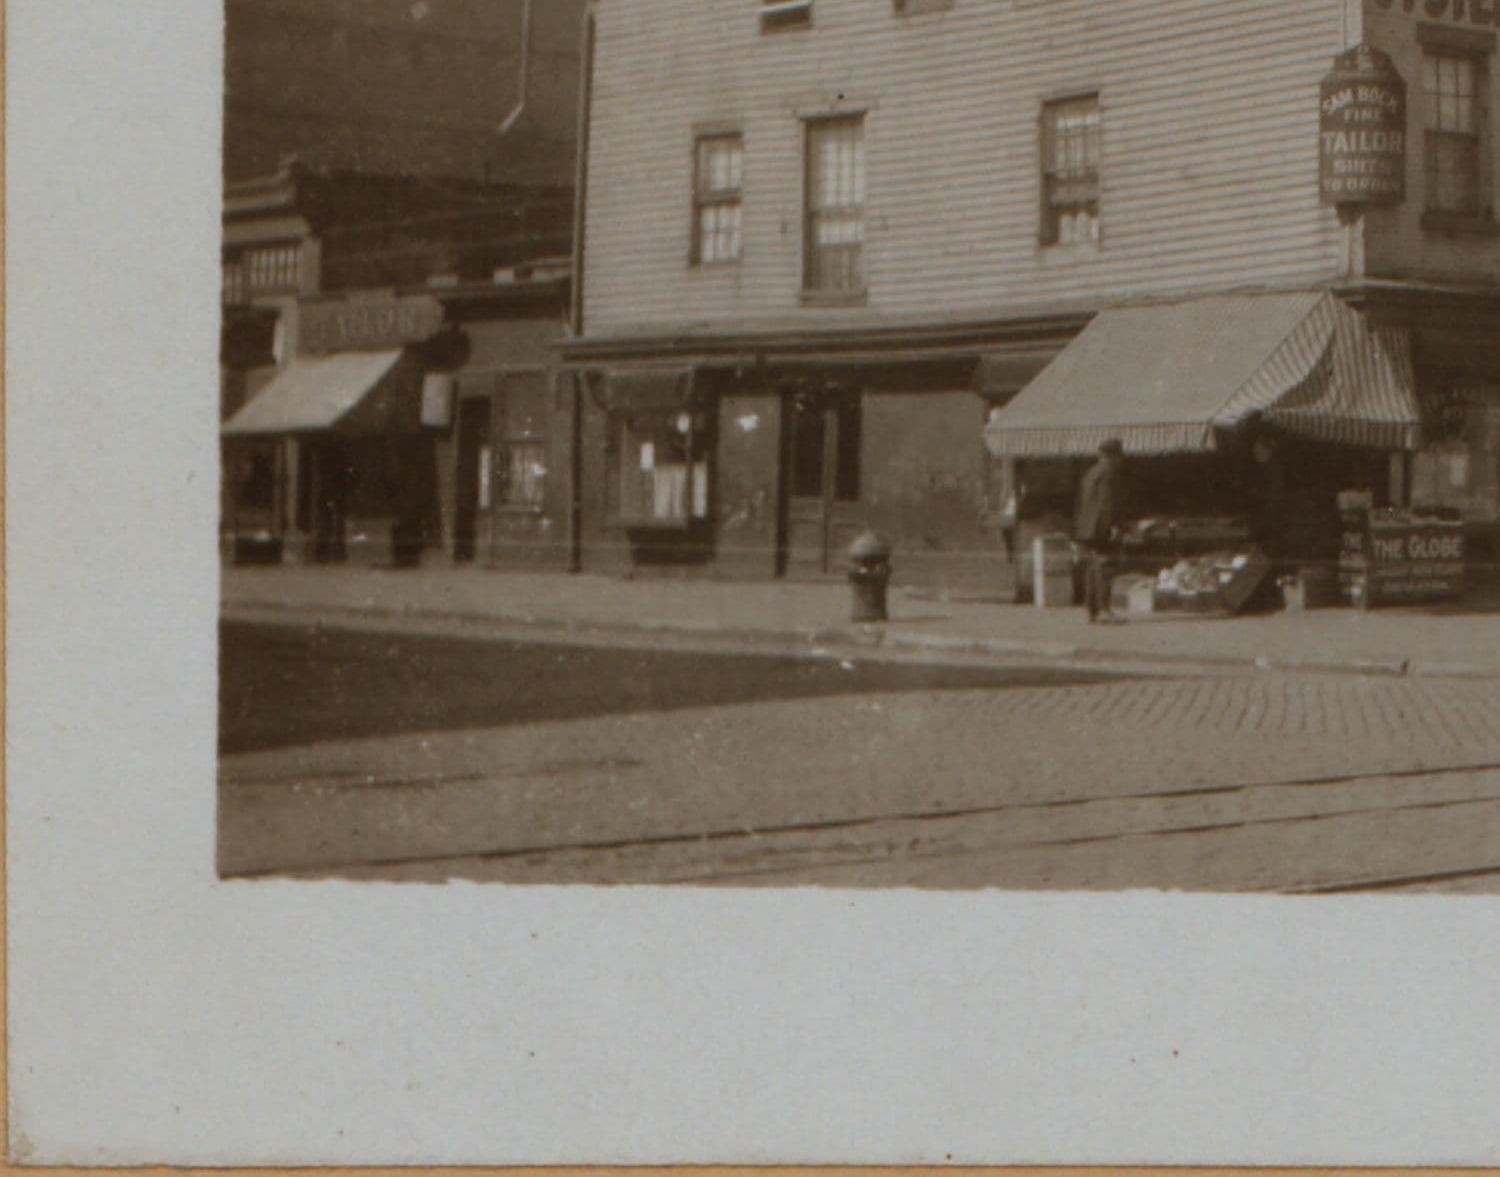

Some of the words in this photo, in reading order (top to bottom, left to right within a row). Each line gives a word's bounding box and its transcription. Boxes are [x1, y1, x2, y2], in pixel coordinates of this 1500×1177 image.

[1322, 130, 1403, 155] TAILOR
[1372, 538, 1405, 559] THE
[1408, 534, 1463, 559] GLOBE
